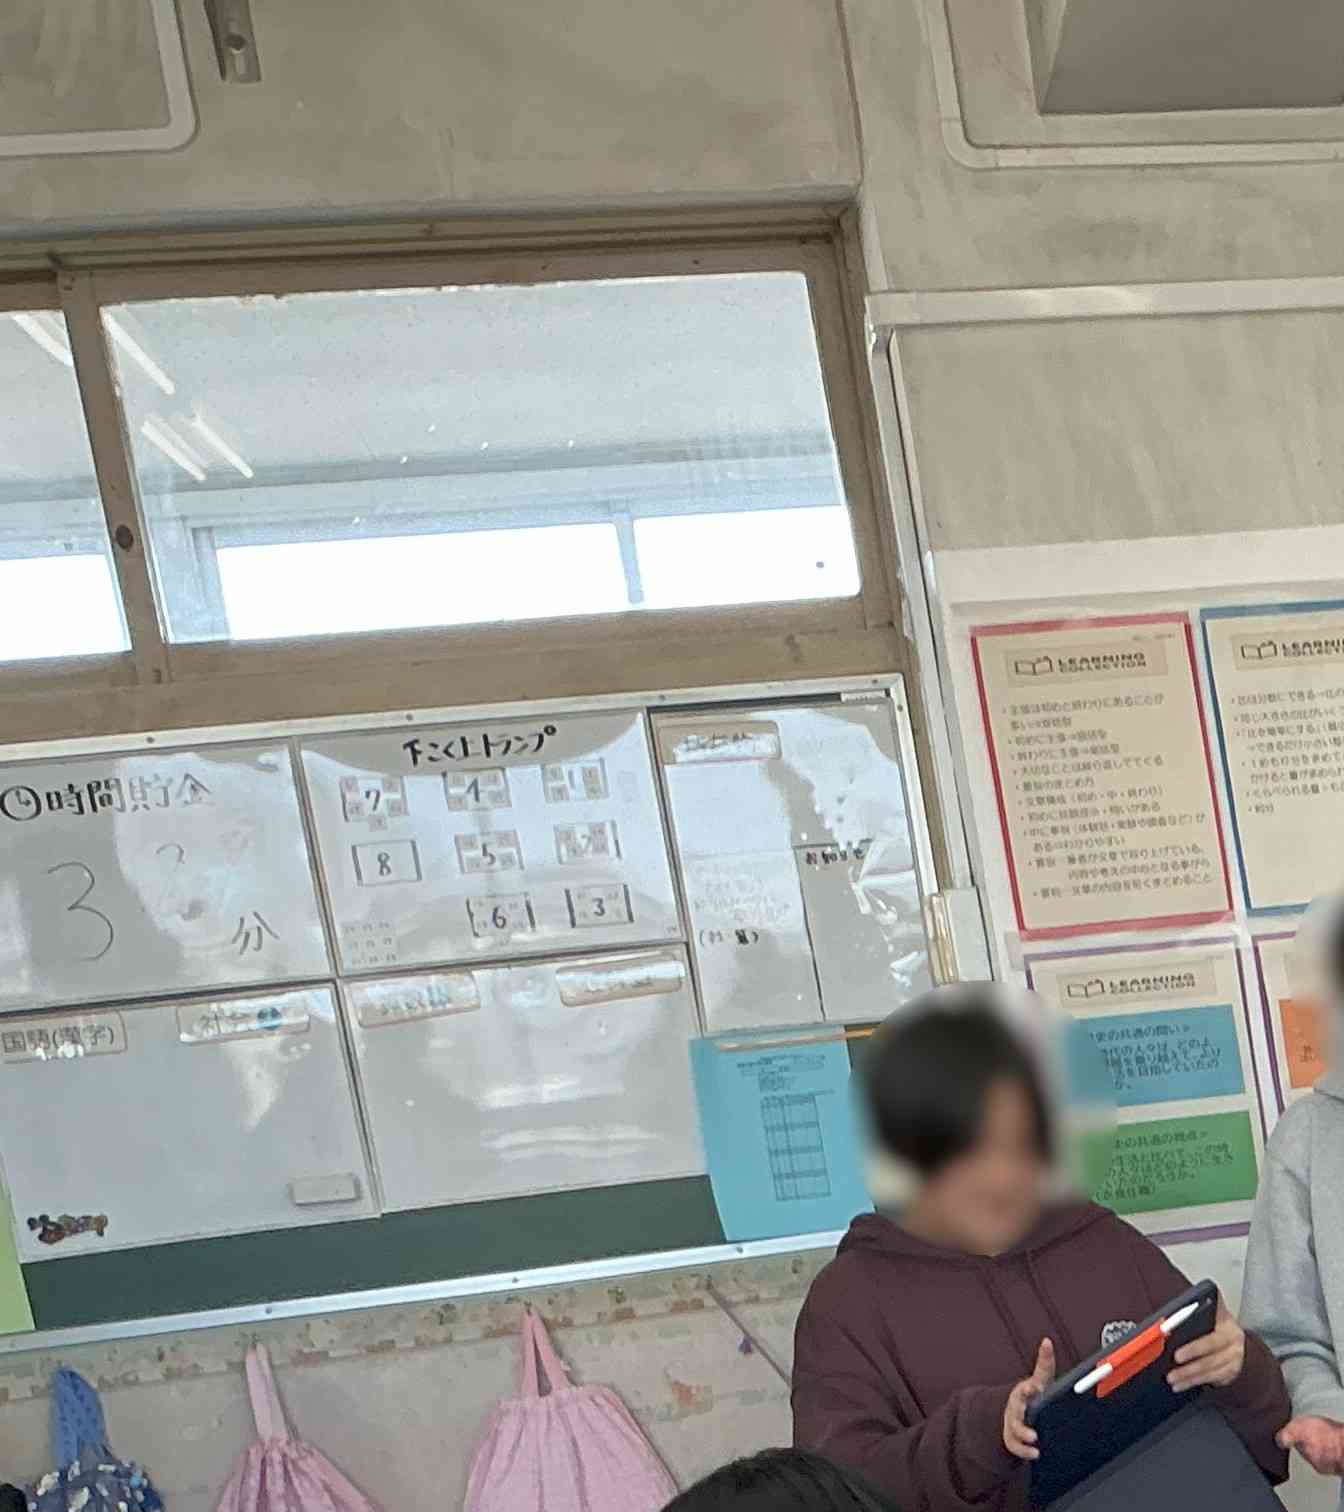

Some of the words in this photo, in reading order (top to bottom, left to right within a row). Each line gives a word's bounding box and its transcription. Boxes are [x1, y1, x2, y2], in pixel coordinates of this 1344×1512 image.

[1058, 652, 1146, 667] LEARNING
[1059, 660, 1147, 674] COLLECTION
[376, 851, 392, 877] 8
[48, 861, 114, 960] 3
[490, 906, 507, 930] 6
[231, 911, 281, 956] 分
[1110, 972, 1196, 989] LEARNING
